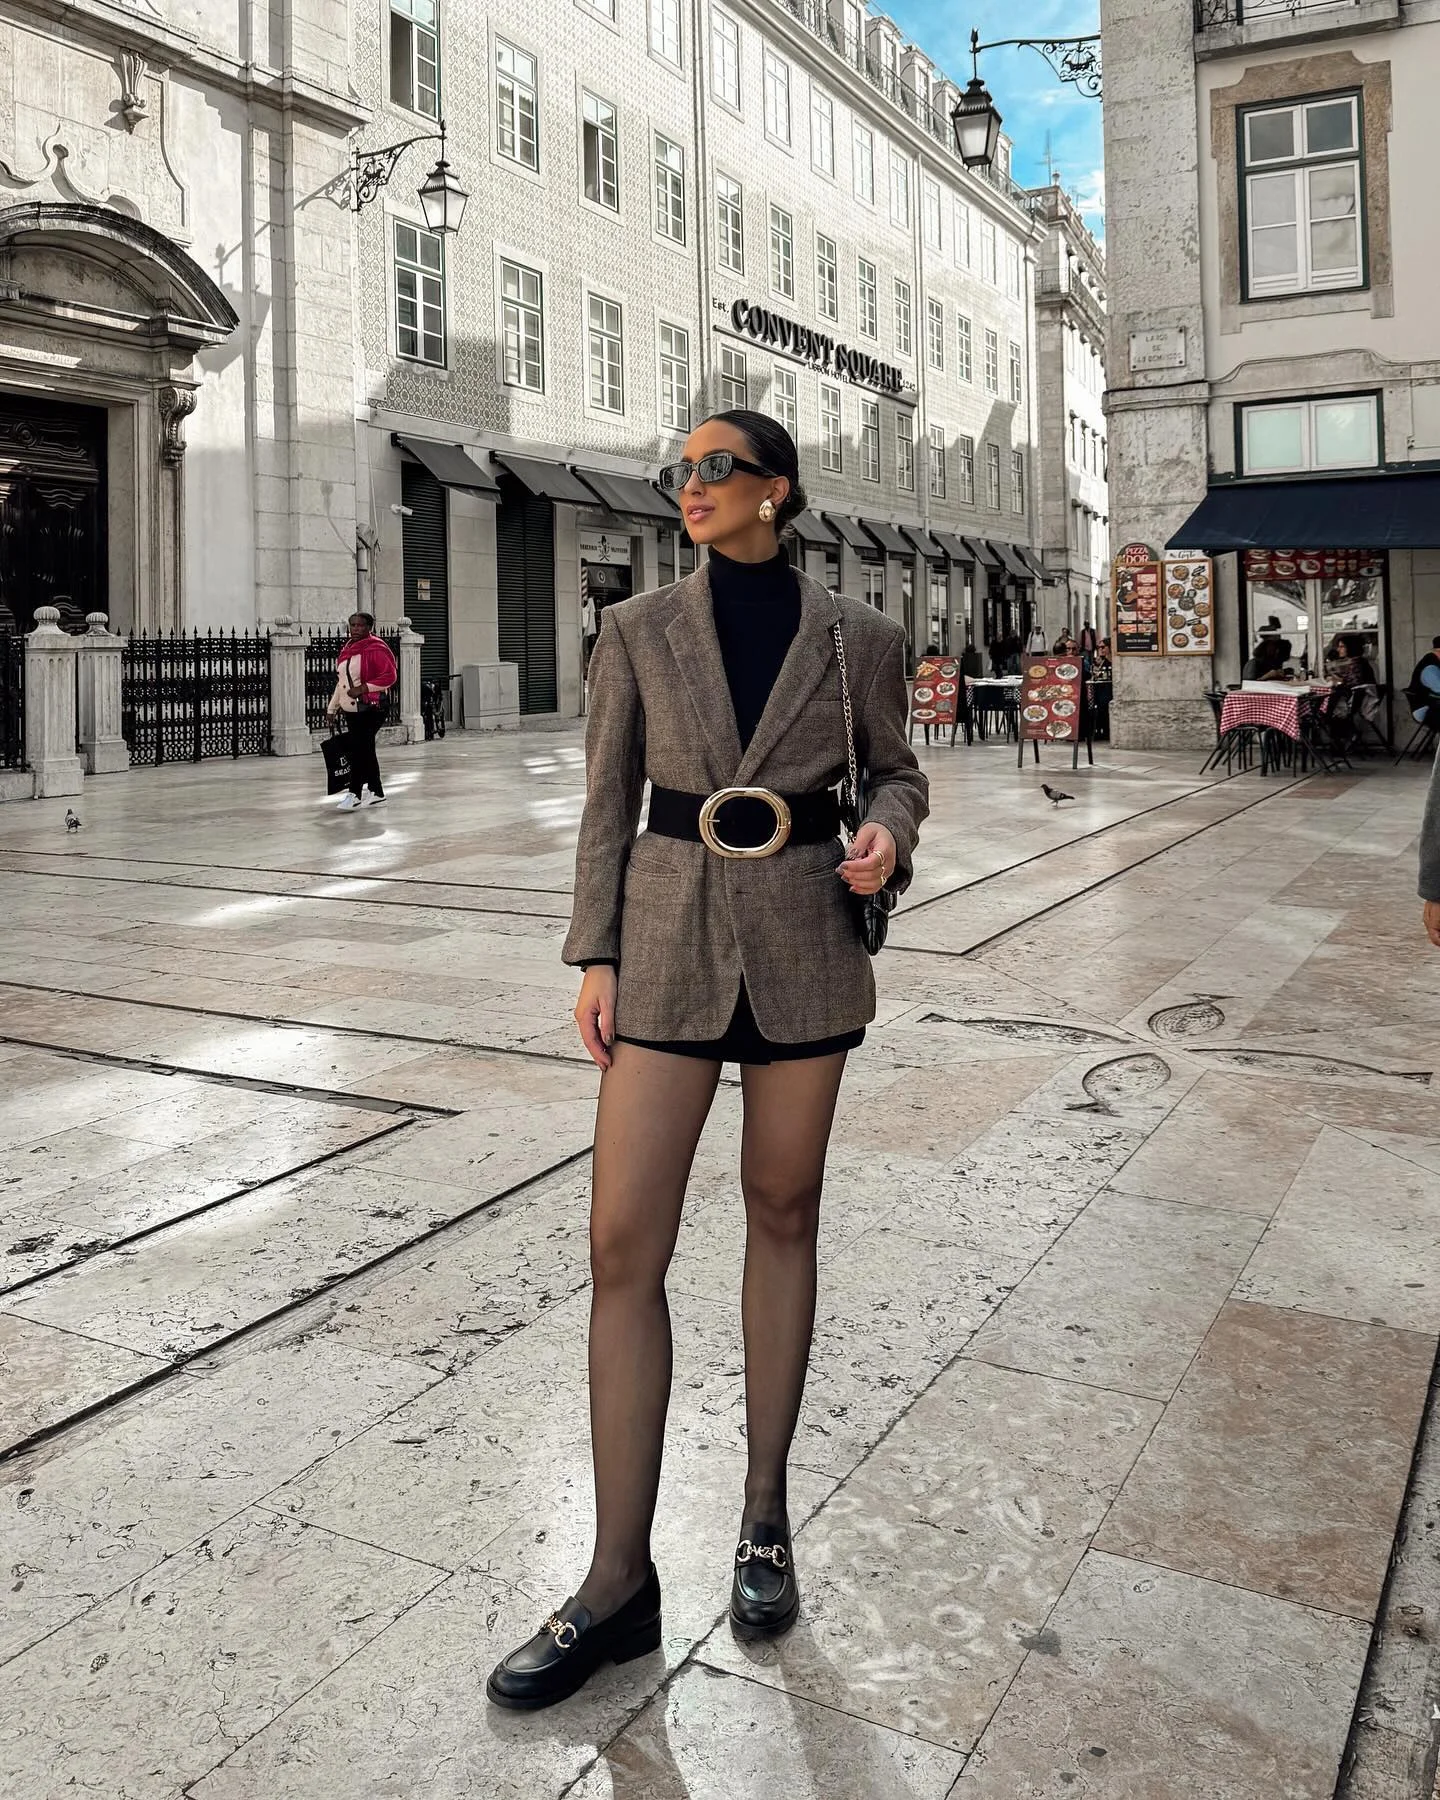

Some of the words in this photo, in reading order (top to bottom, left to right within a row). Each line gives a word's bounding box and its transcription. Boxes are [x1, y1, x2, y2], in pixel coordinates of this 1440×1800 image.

[731, 298, 834, 366] CONVENT
[834, 343, 904, 392] SQUARE
[831, 370, 849, 384] HOTEL
[334, 765, 351, 776] SEAS
